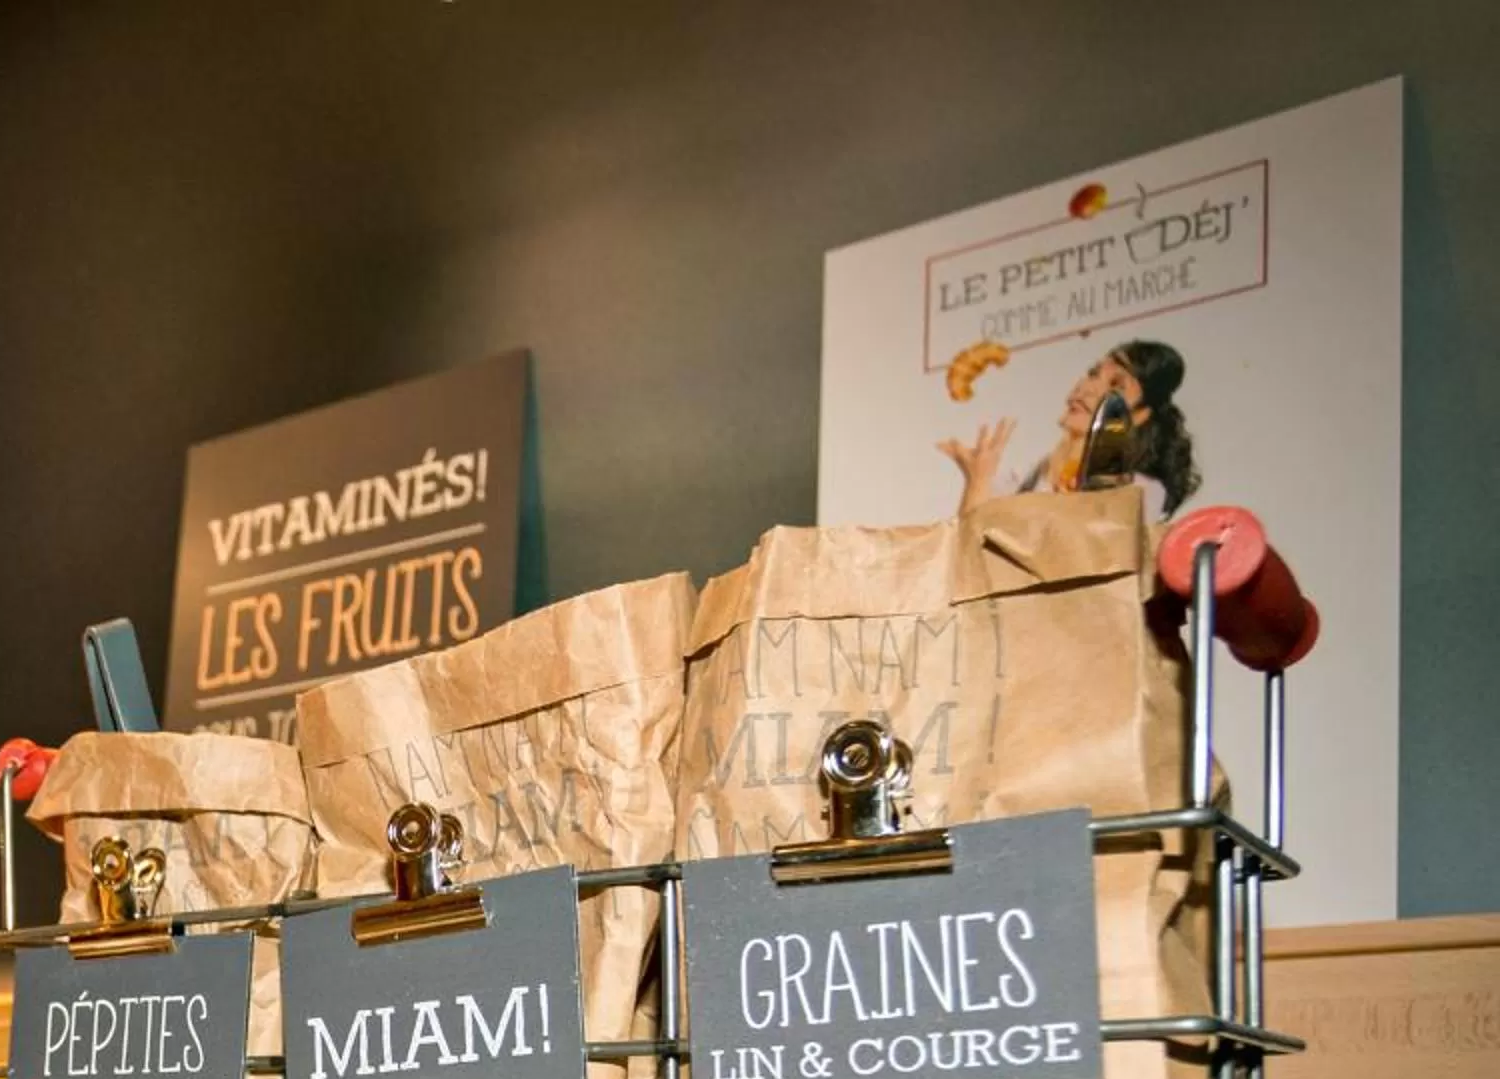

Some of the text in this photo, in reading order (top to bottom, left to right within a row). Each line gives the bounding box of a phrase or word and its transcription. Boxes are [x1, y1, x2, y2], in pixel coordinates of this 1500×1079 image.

[938, 272, 989, 313] LE
[998, 235, 1116, 296] PETIT
[208, 448, 490, 567] VITAMINÉS!
[195, 546, 484, 692] LES FRUITS
[739, 909, 1037, 1030] GRAINES
[43, 989, 208, 1077] PÉPITES
[799, 1042, 833, 1078] &
[848, 1022, 1082, 1076] COURGE
